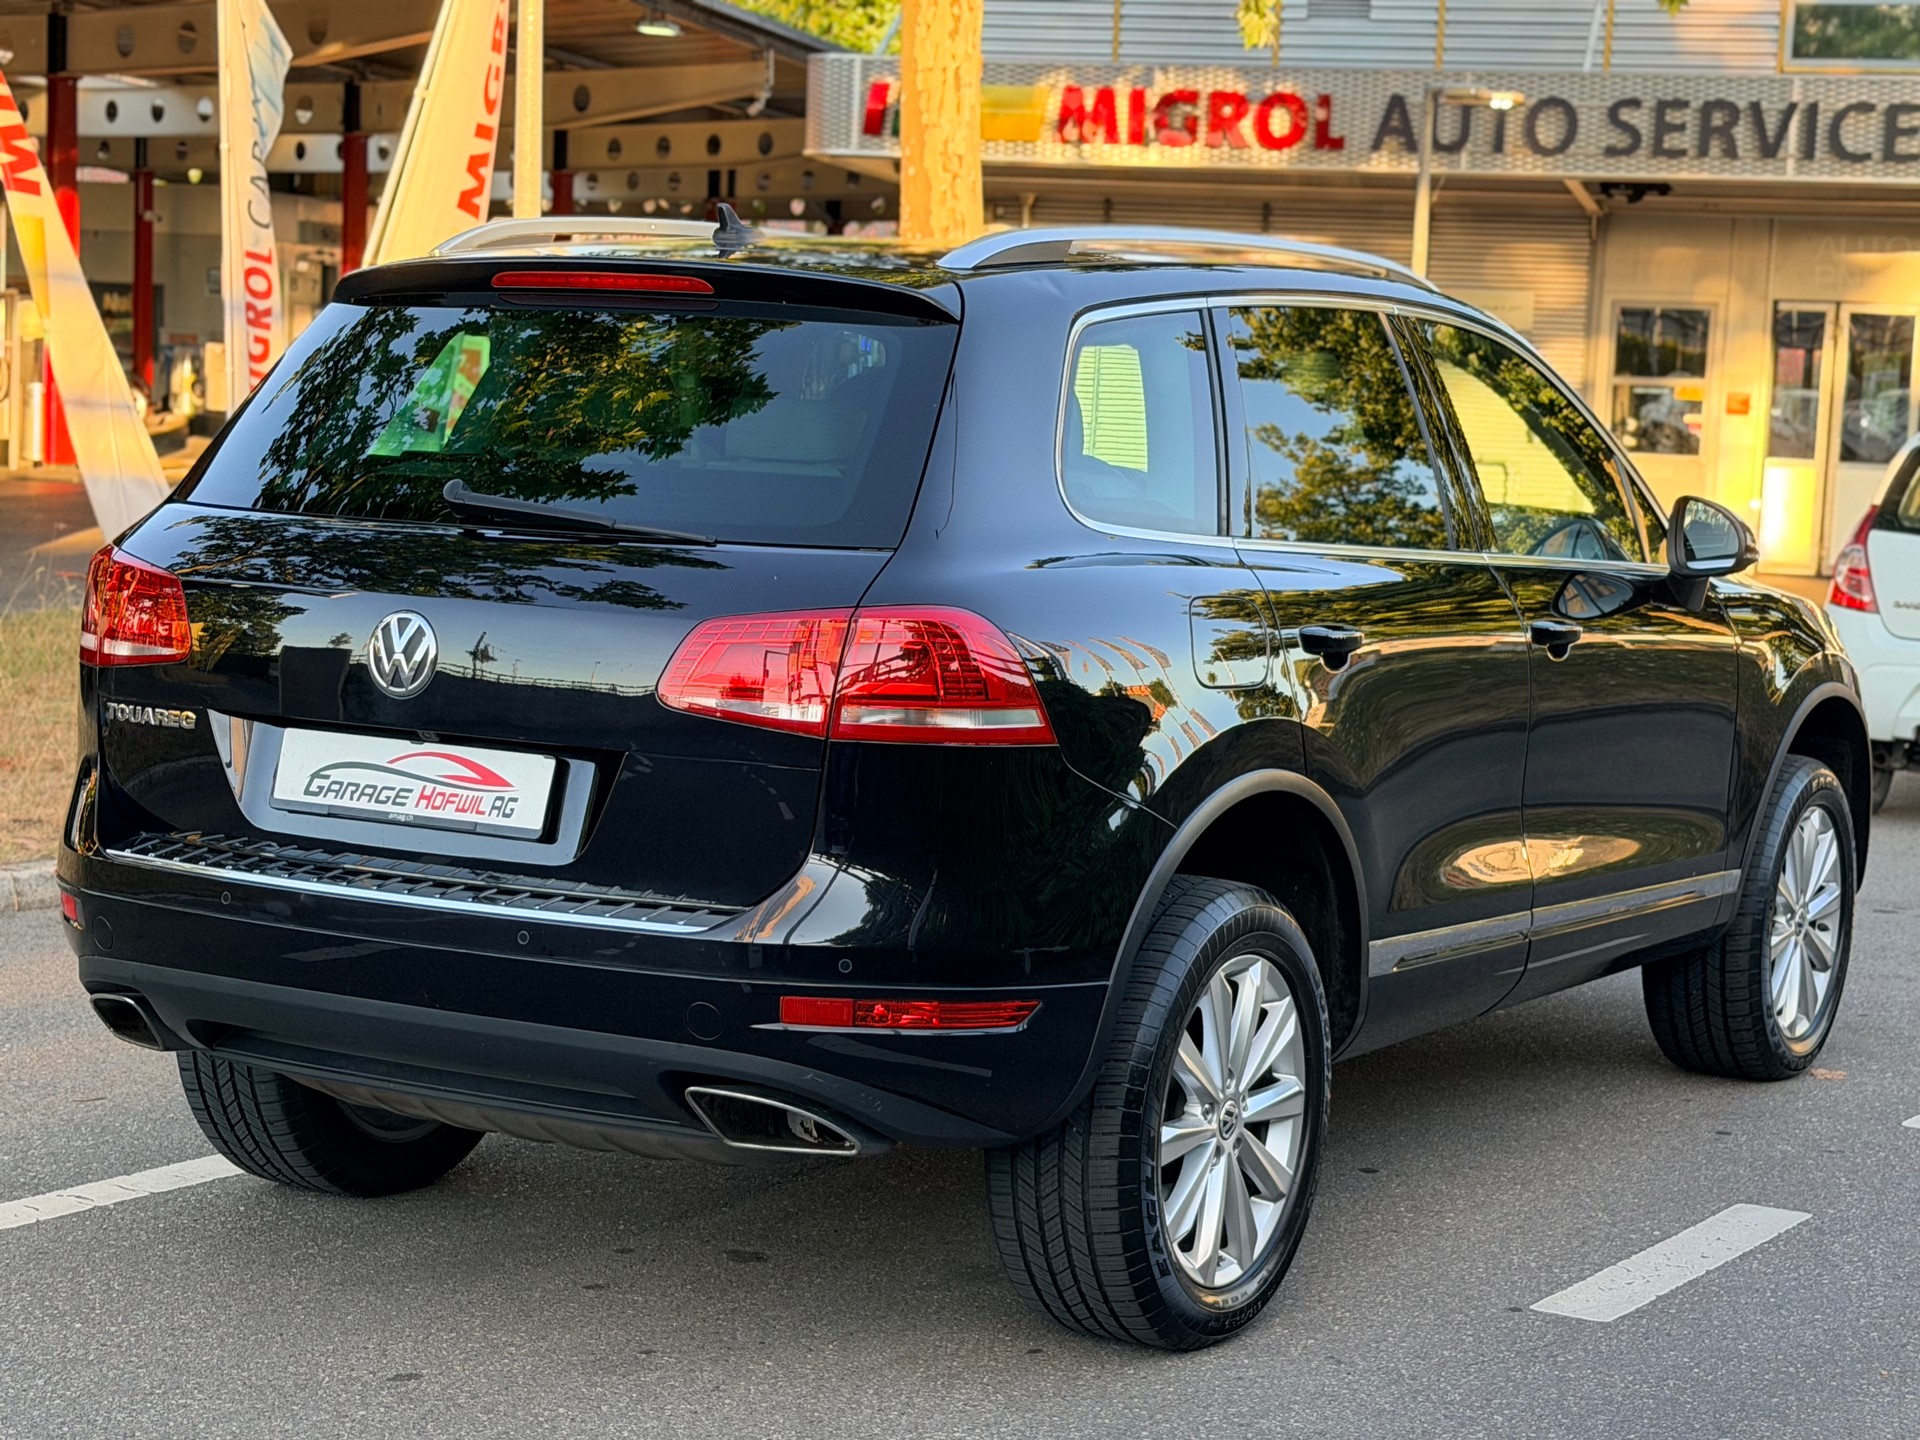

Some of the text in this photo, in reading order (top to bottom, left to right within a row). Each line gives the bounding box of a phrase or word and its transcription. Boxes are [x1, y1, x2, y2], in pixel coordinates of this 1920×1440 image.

[456, 0, 507, 221] MIGR
[1052, 85, 1345, 151] MIGROL
[1604, 97, 1920, 163] SERVICE
[244, 248, 273, 391] IGROL
[107, 702, 197, 730] TOUAREG
[303, 771, 520, 819] GARAGE HOFWIL AG
[388, 811, 414, 823] amag.ch
